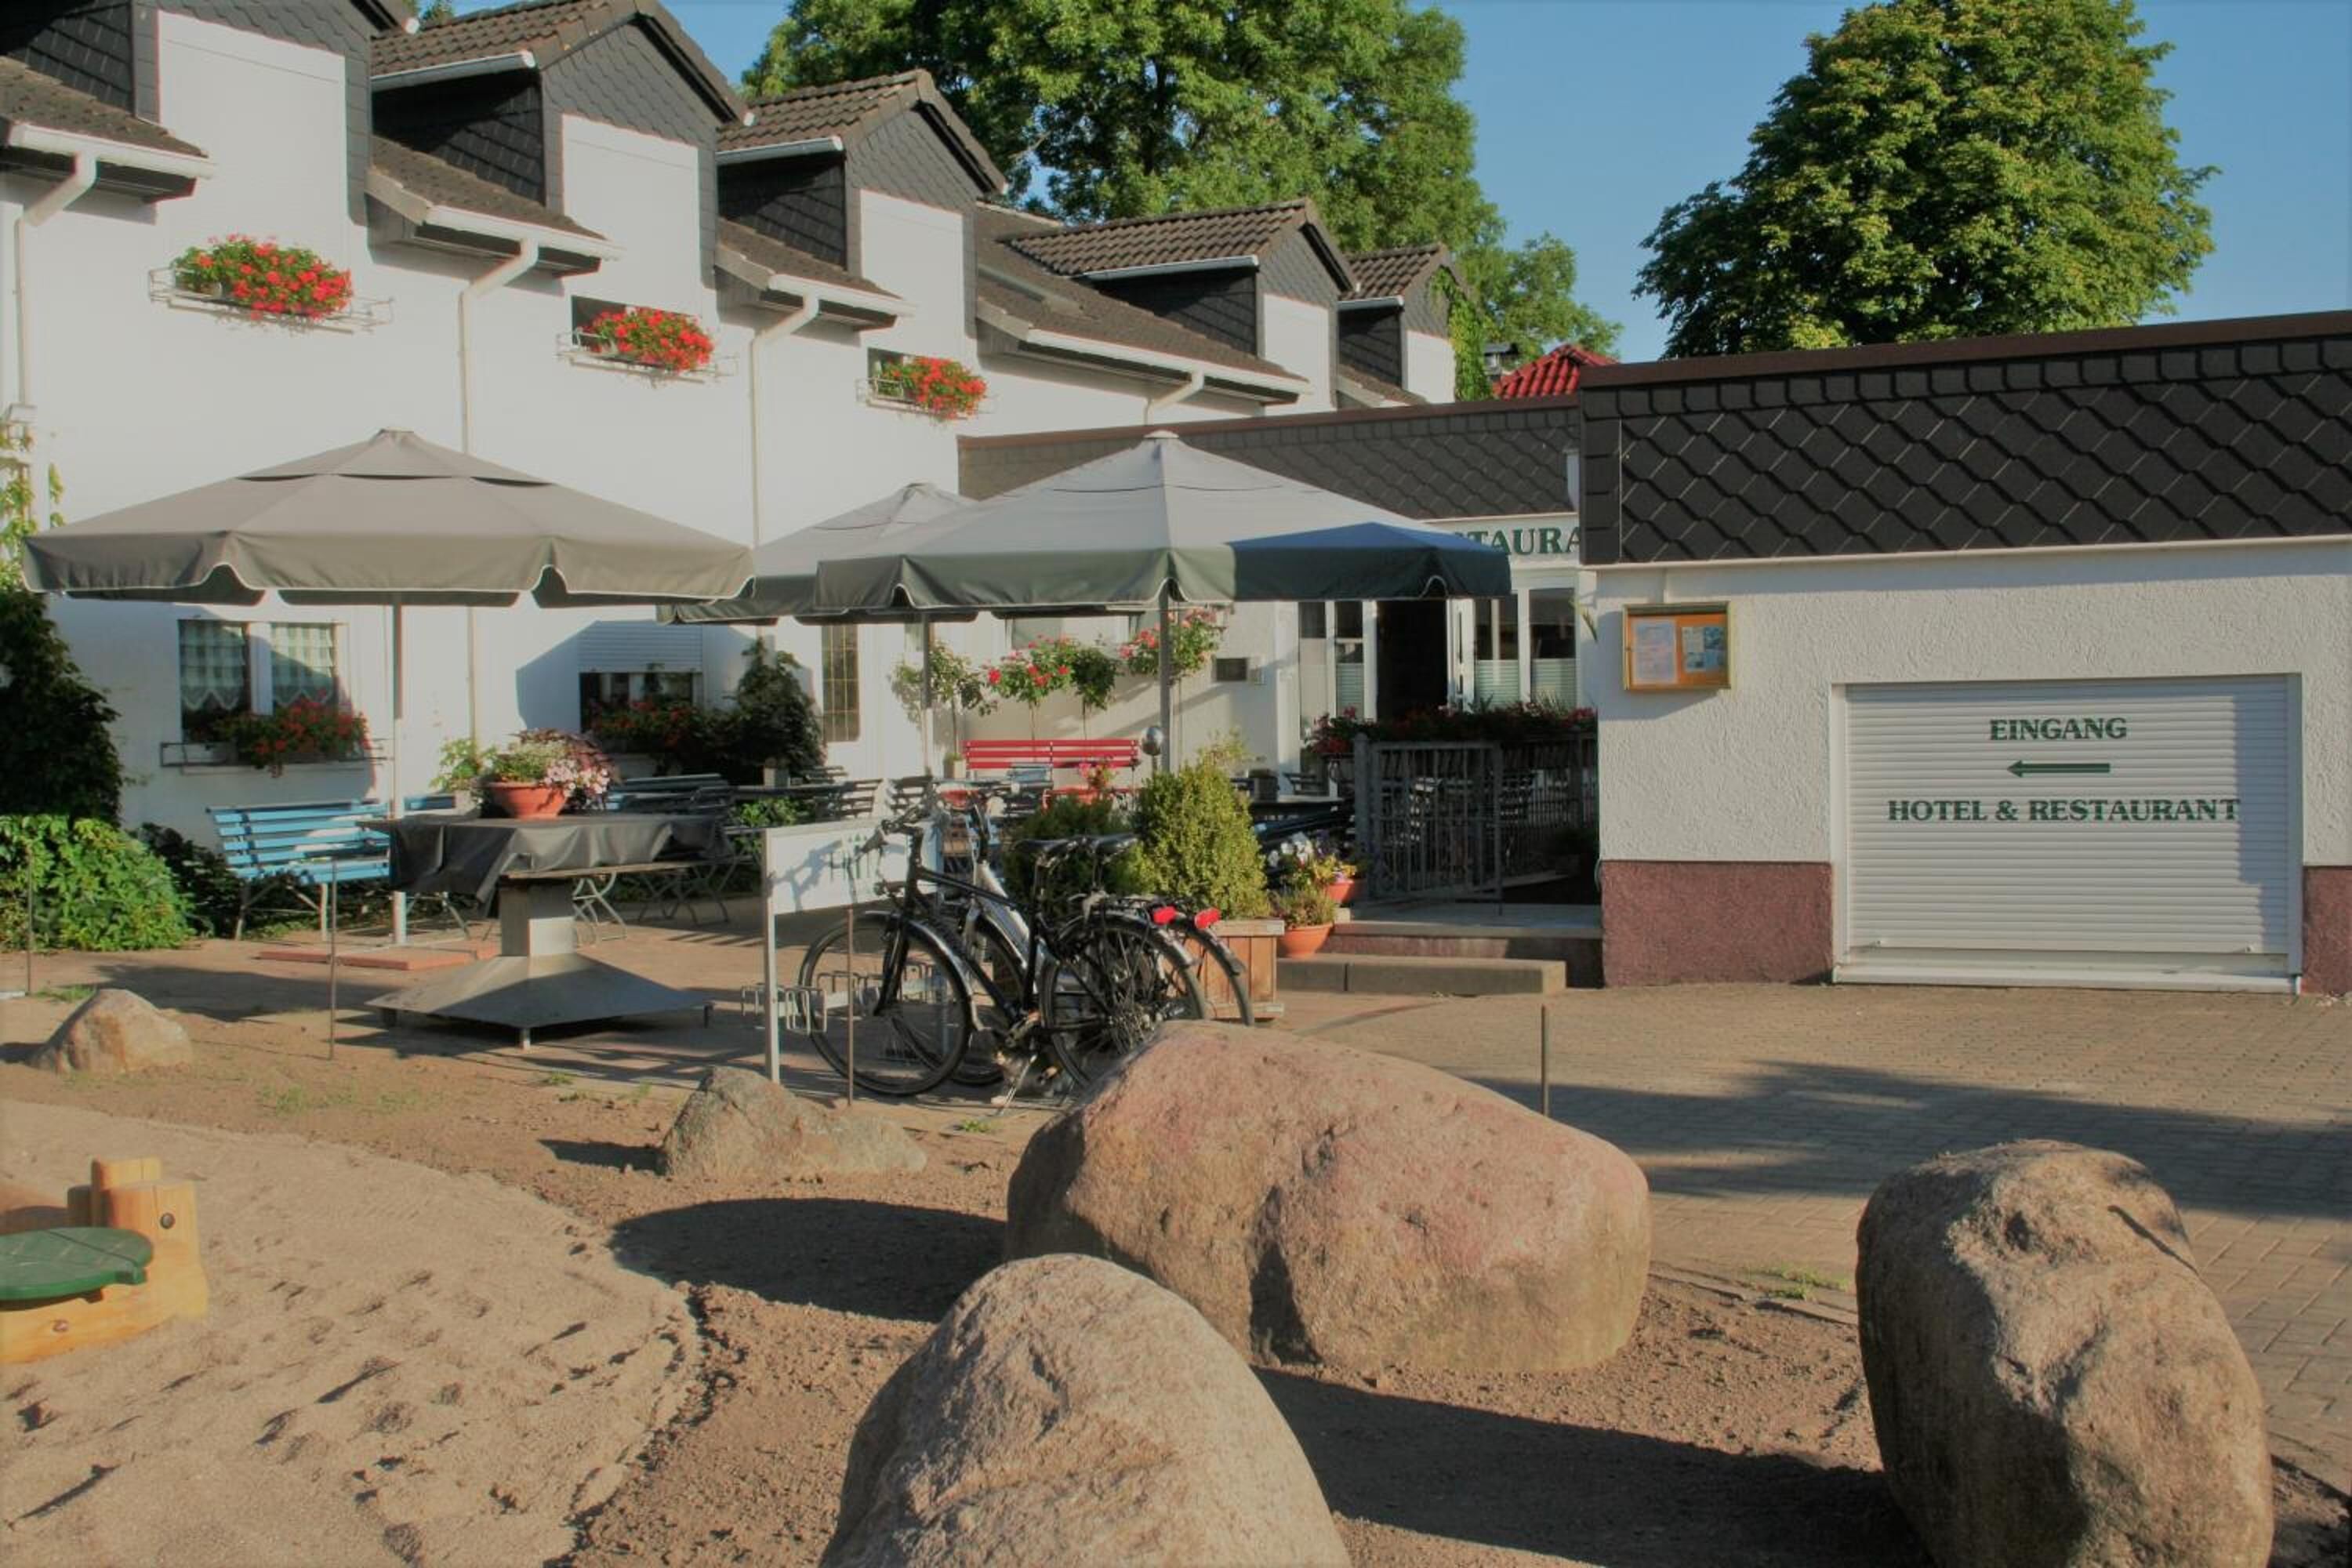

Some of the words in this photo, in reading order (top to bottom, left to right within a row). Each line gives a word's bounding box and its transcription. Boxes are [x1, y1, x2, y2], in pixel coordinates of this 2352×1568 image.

[1990, 717, 2127, 740] EINGANG
[1888, 800, 1987, 821] HOTEL
[1995, 800, 2019, 821] &
[2028, 799, 2241, 822] RESTAURANT
